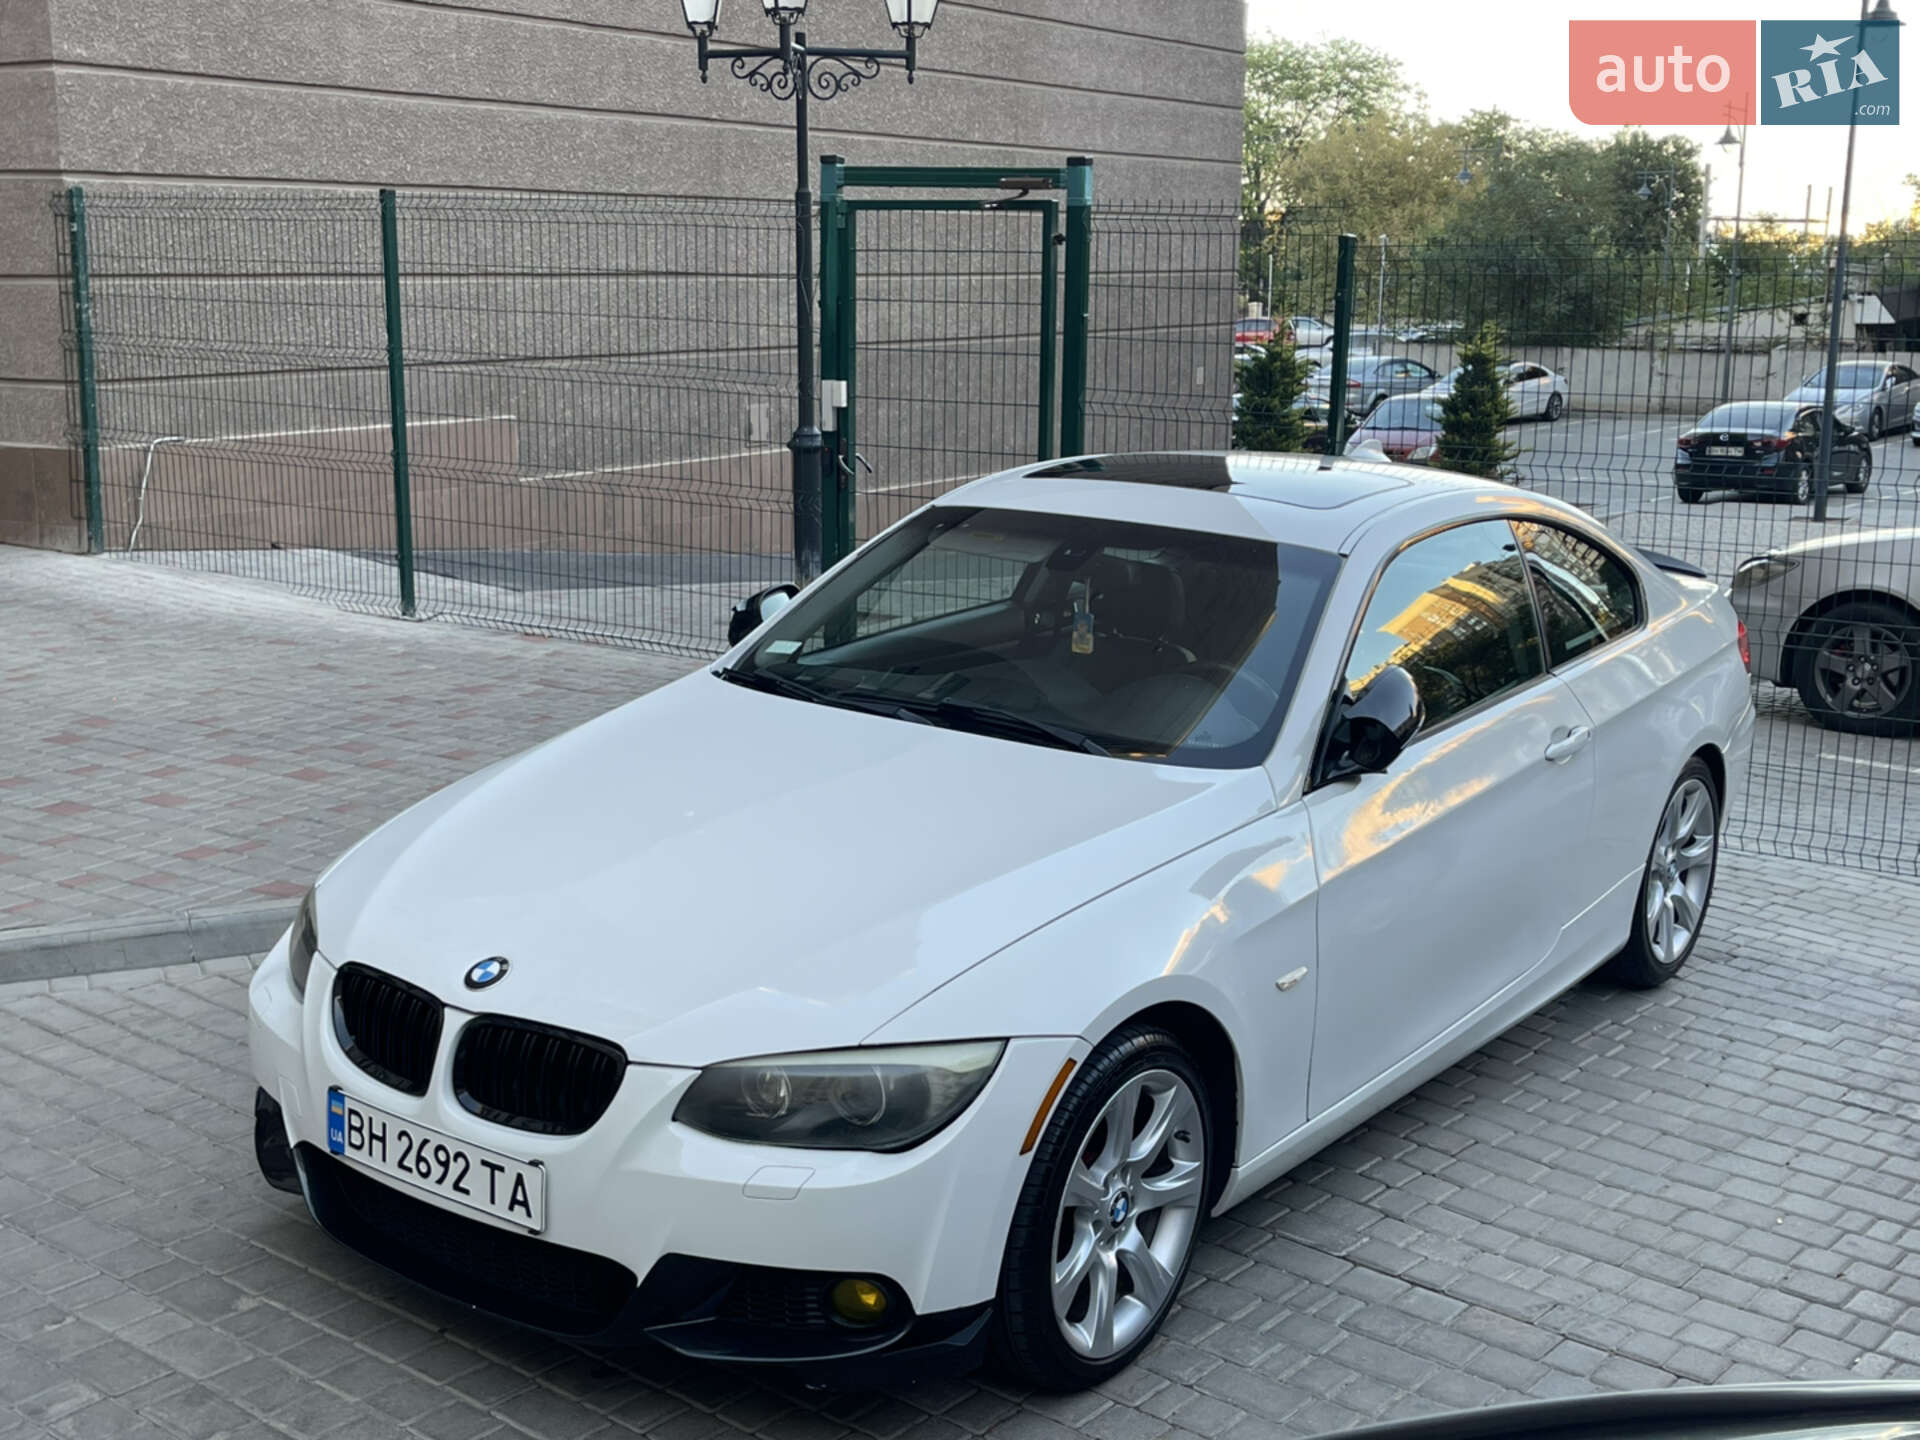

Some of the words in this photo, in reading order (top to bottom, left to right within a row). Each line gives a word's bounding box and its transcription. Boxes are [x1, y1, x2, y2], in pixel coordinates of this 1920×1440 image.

[330, 1126, 344, 1144] UA
[347, 1107, 387, 1164] BH
[397, 1130, 471, 1197] 2692
[480, 1158, 533, 1219] TA
